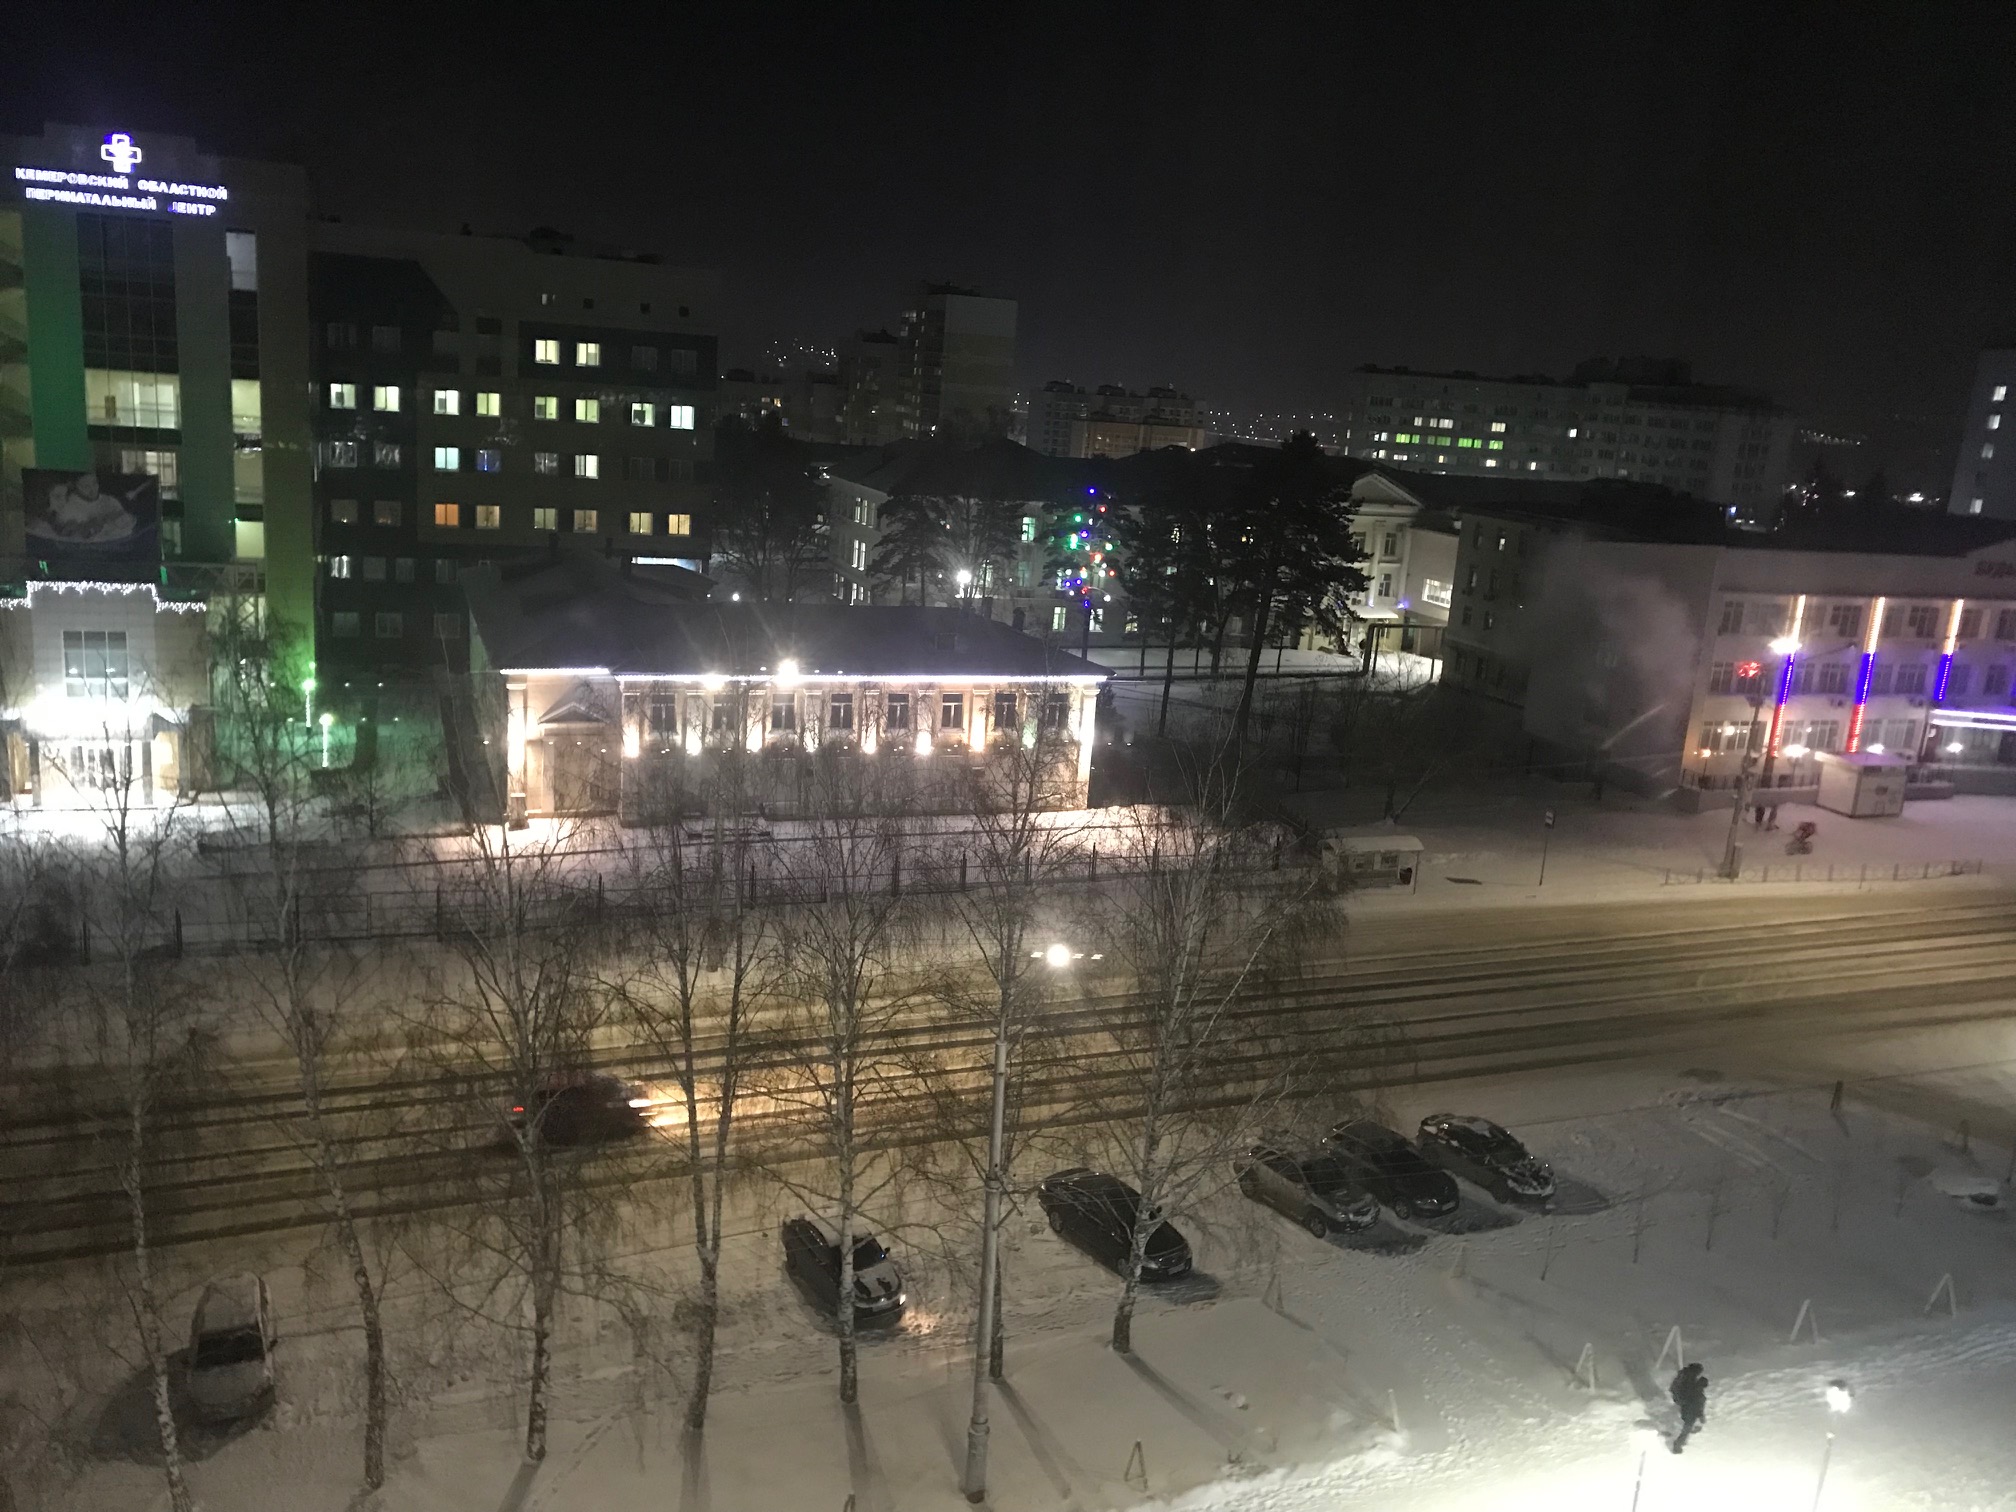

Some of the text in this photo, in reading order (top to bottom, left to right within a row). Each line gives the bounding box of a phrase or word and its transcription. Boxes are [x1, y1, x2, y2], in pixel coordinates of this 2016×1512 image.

[15, 167, 228, 200] КЕМЕРОВСКИЙ ОБЛАСТНОЙ
[25, 187, 157, 210] ПЕРИНАТАЛЬНЫЙ
